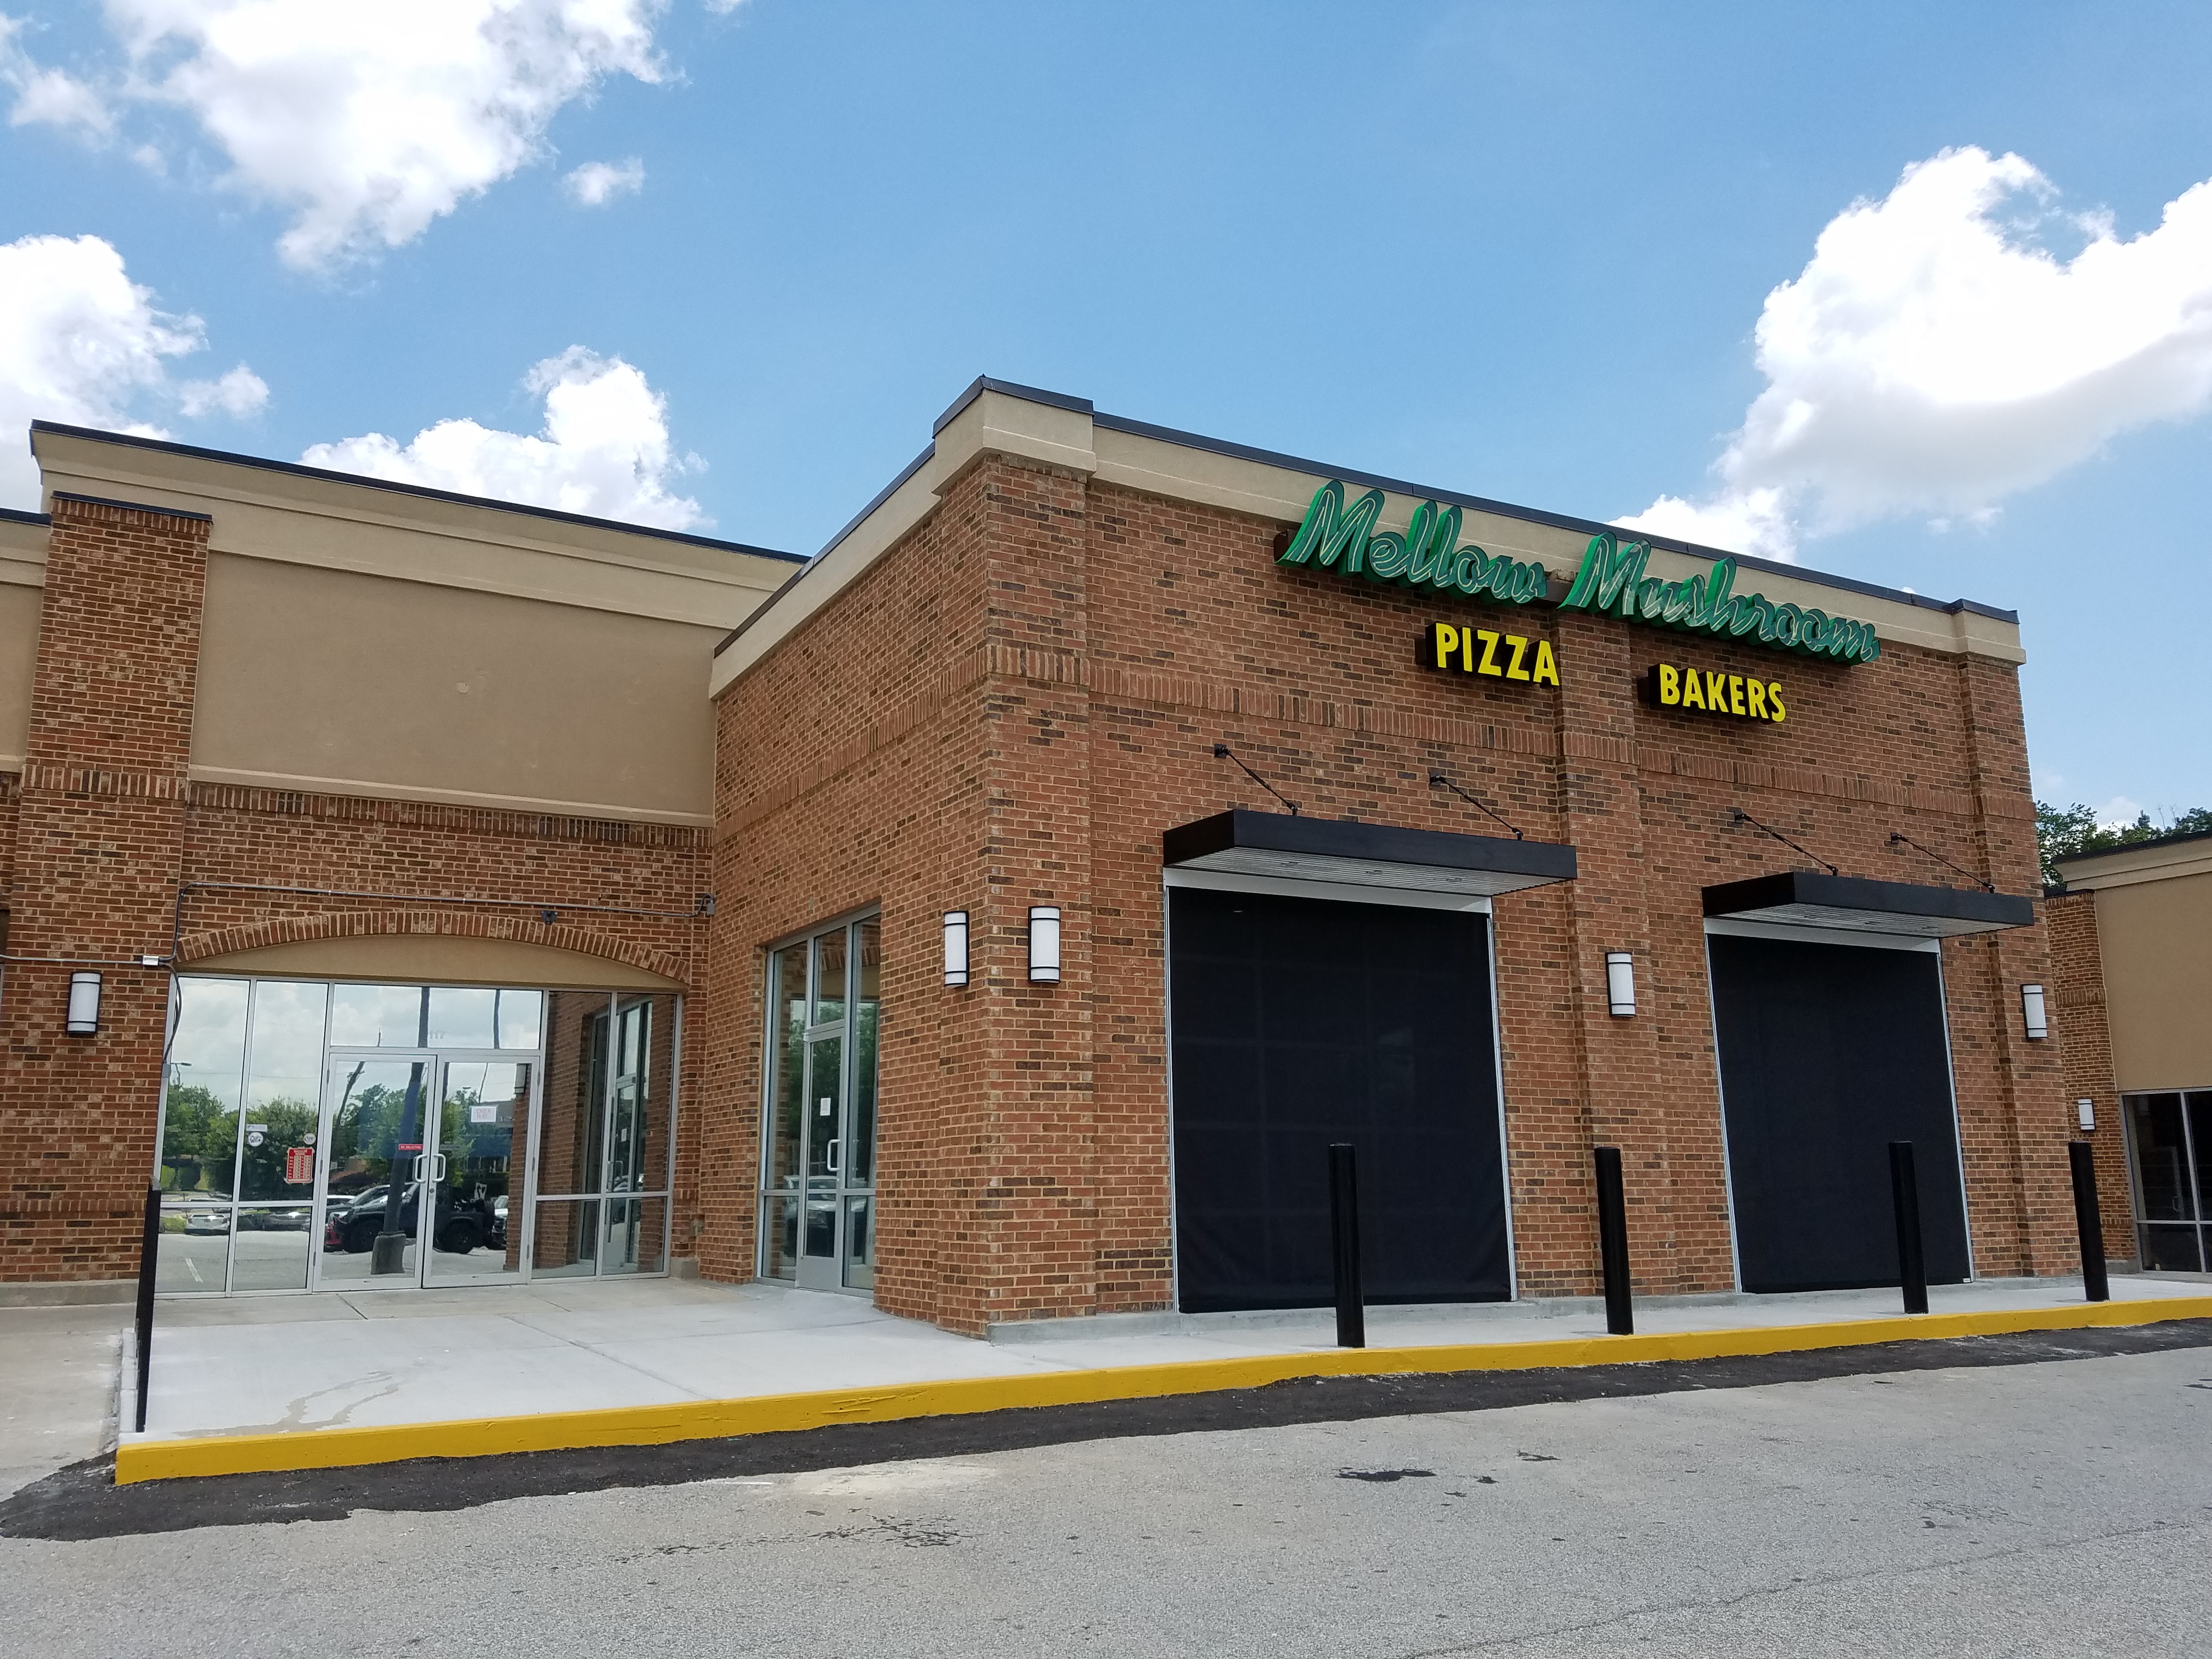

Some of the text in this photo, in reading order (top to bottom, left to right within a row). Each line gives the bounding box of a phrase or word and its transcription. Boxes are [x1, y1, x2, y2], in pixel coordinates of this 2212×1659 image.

[1275, 480, 1881, 664] Mellow Mushroom
[1435, 622, 1560, 686] PIZZA
[1659, 663, 1786, 723] BAKERS
